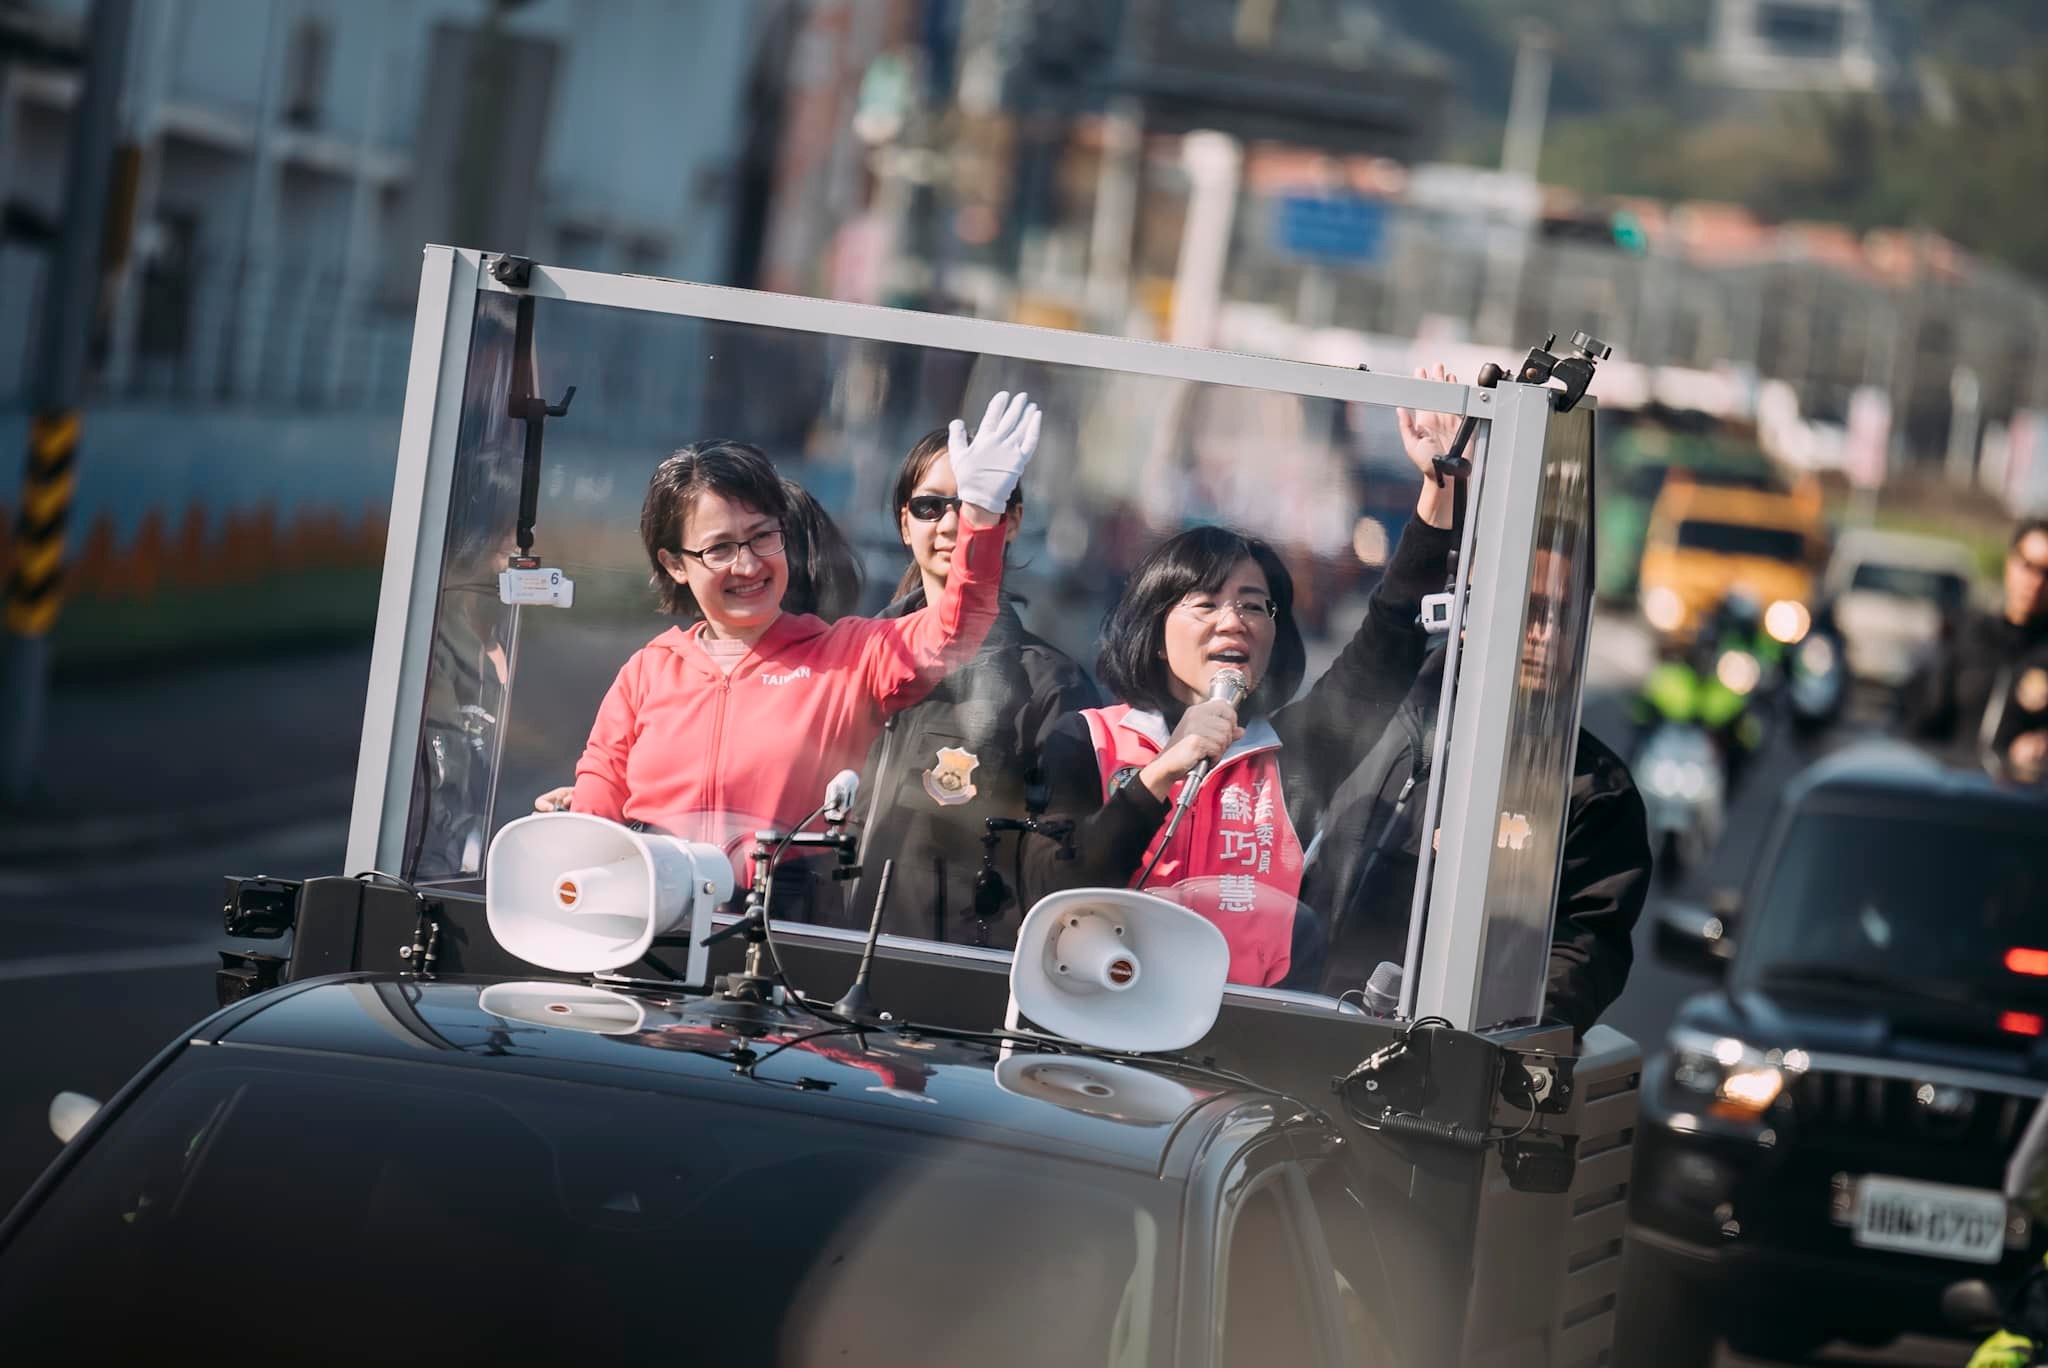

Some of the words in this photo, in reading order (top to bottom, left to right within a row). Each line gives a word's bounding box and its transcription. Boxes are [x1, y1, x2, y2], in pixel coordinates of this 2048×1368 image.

[551, 572, 559, 585] 6
[1219, 783, 1257, 912] 蘇巧慧
